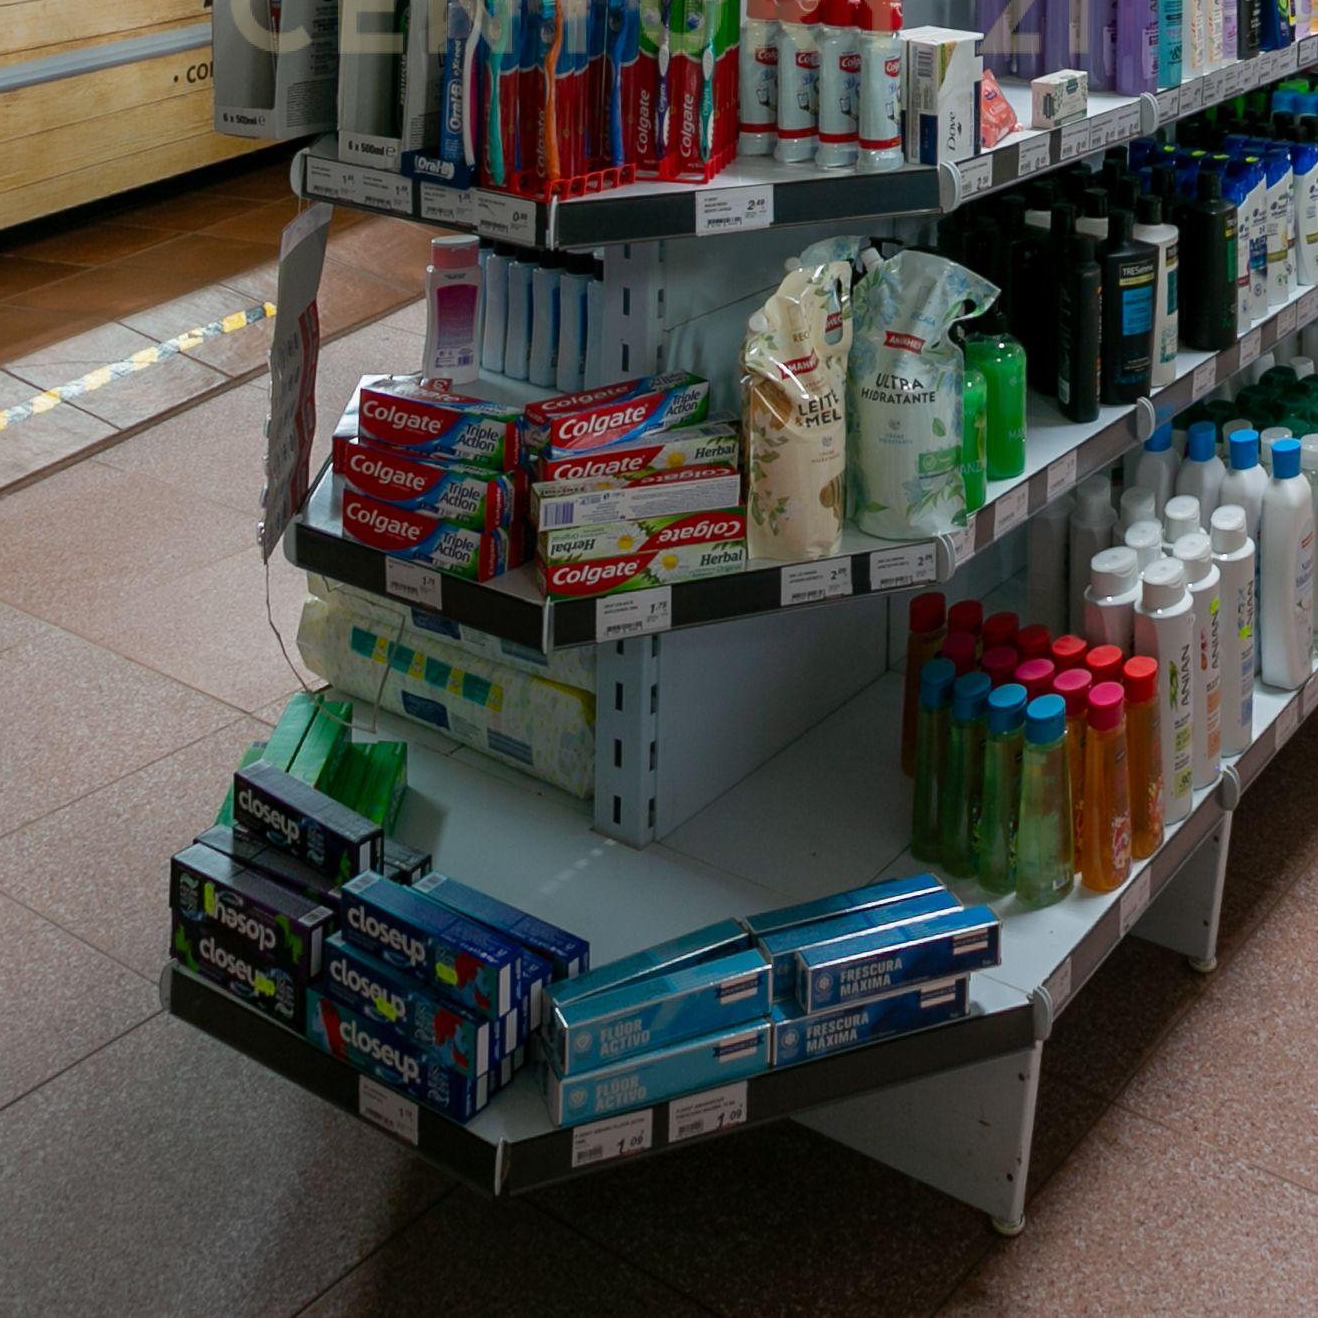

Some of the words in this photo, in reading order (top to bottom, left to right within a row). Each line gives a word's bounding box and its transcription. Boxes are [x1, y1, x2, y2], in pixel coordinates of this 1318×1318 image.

[448, 83, 462, 132] Oral-B
[637, 89, 651, 154] Colgate
[681, 93, 694, 158] Colgate
[946, 111, 957, 152] Dove
[361, 140, 385, 156] 500ml
[416, 155, 452, 178] Oral-B
[875, 372, 924, 391] ULTRA
[541, 385, 631, 411] Colgate
[666, 400, 698, 417] Action
[672, 391, 701, 406] Triple
[861, 388, 936, 404] HIDRATANTE
[361, 399, 442, 434] Colgate
[558, 403, 647, 440] Colgate
[806, 411, 842, 428] MEL
[458, 435, 496, 452] Action
[465, 423, 499, 442] Triple
[694, 444, 736, 460] Herbal
[350, 453, 426, 492] Colgate
[553, 456, 644, 481] Colgate
[441, 493, 477, 512] Action
[448, 481, 480, 500] Triple
[346, 502, 421, 541] Colgate
[659, 520, 741, 543] Colgate
[434, 543, 470, 564] Action
[442, 533, 474, 552] Triple
[551, 538, 596, 555] Herbal
[700, 550, 743, 566] Herbal
[552, 559, 638, 586] Colgate
[1181, 643, 1190, 707] ANIAN
[238, 788, 301, 847] closeup
[347, 905, 426, 968] closeup
[839, 958, 903, 982] FRESCURA
[329, 955, 407, 1019] closeup
[805, 1011, 870, 1039] FRESCURA
[339, 1020, 421, 1083] closeup
[599, 1029, 651, 1056] ACTIVO
[593, 1086, 648, 1114] ACTIVO
